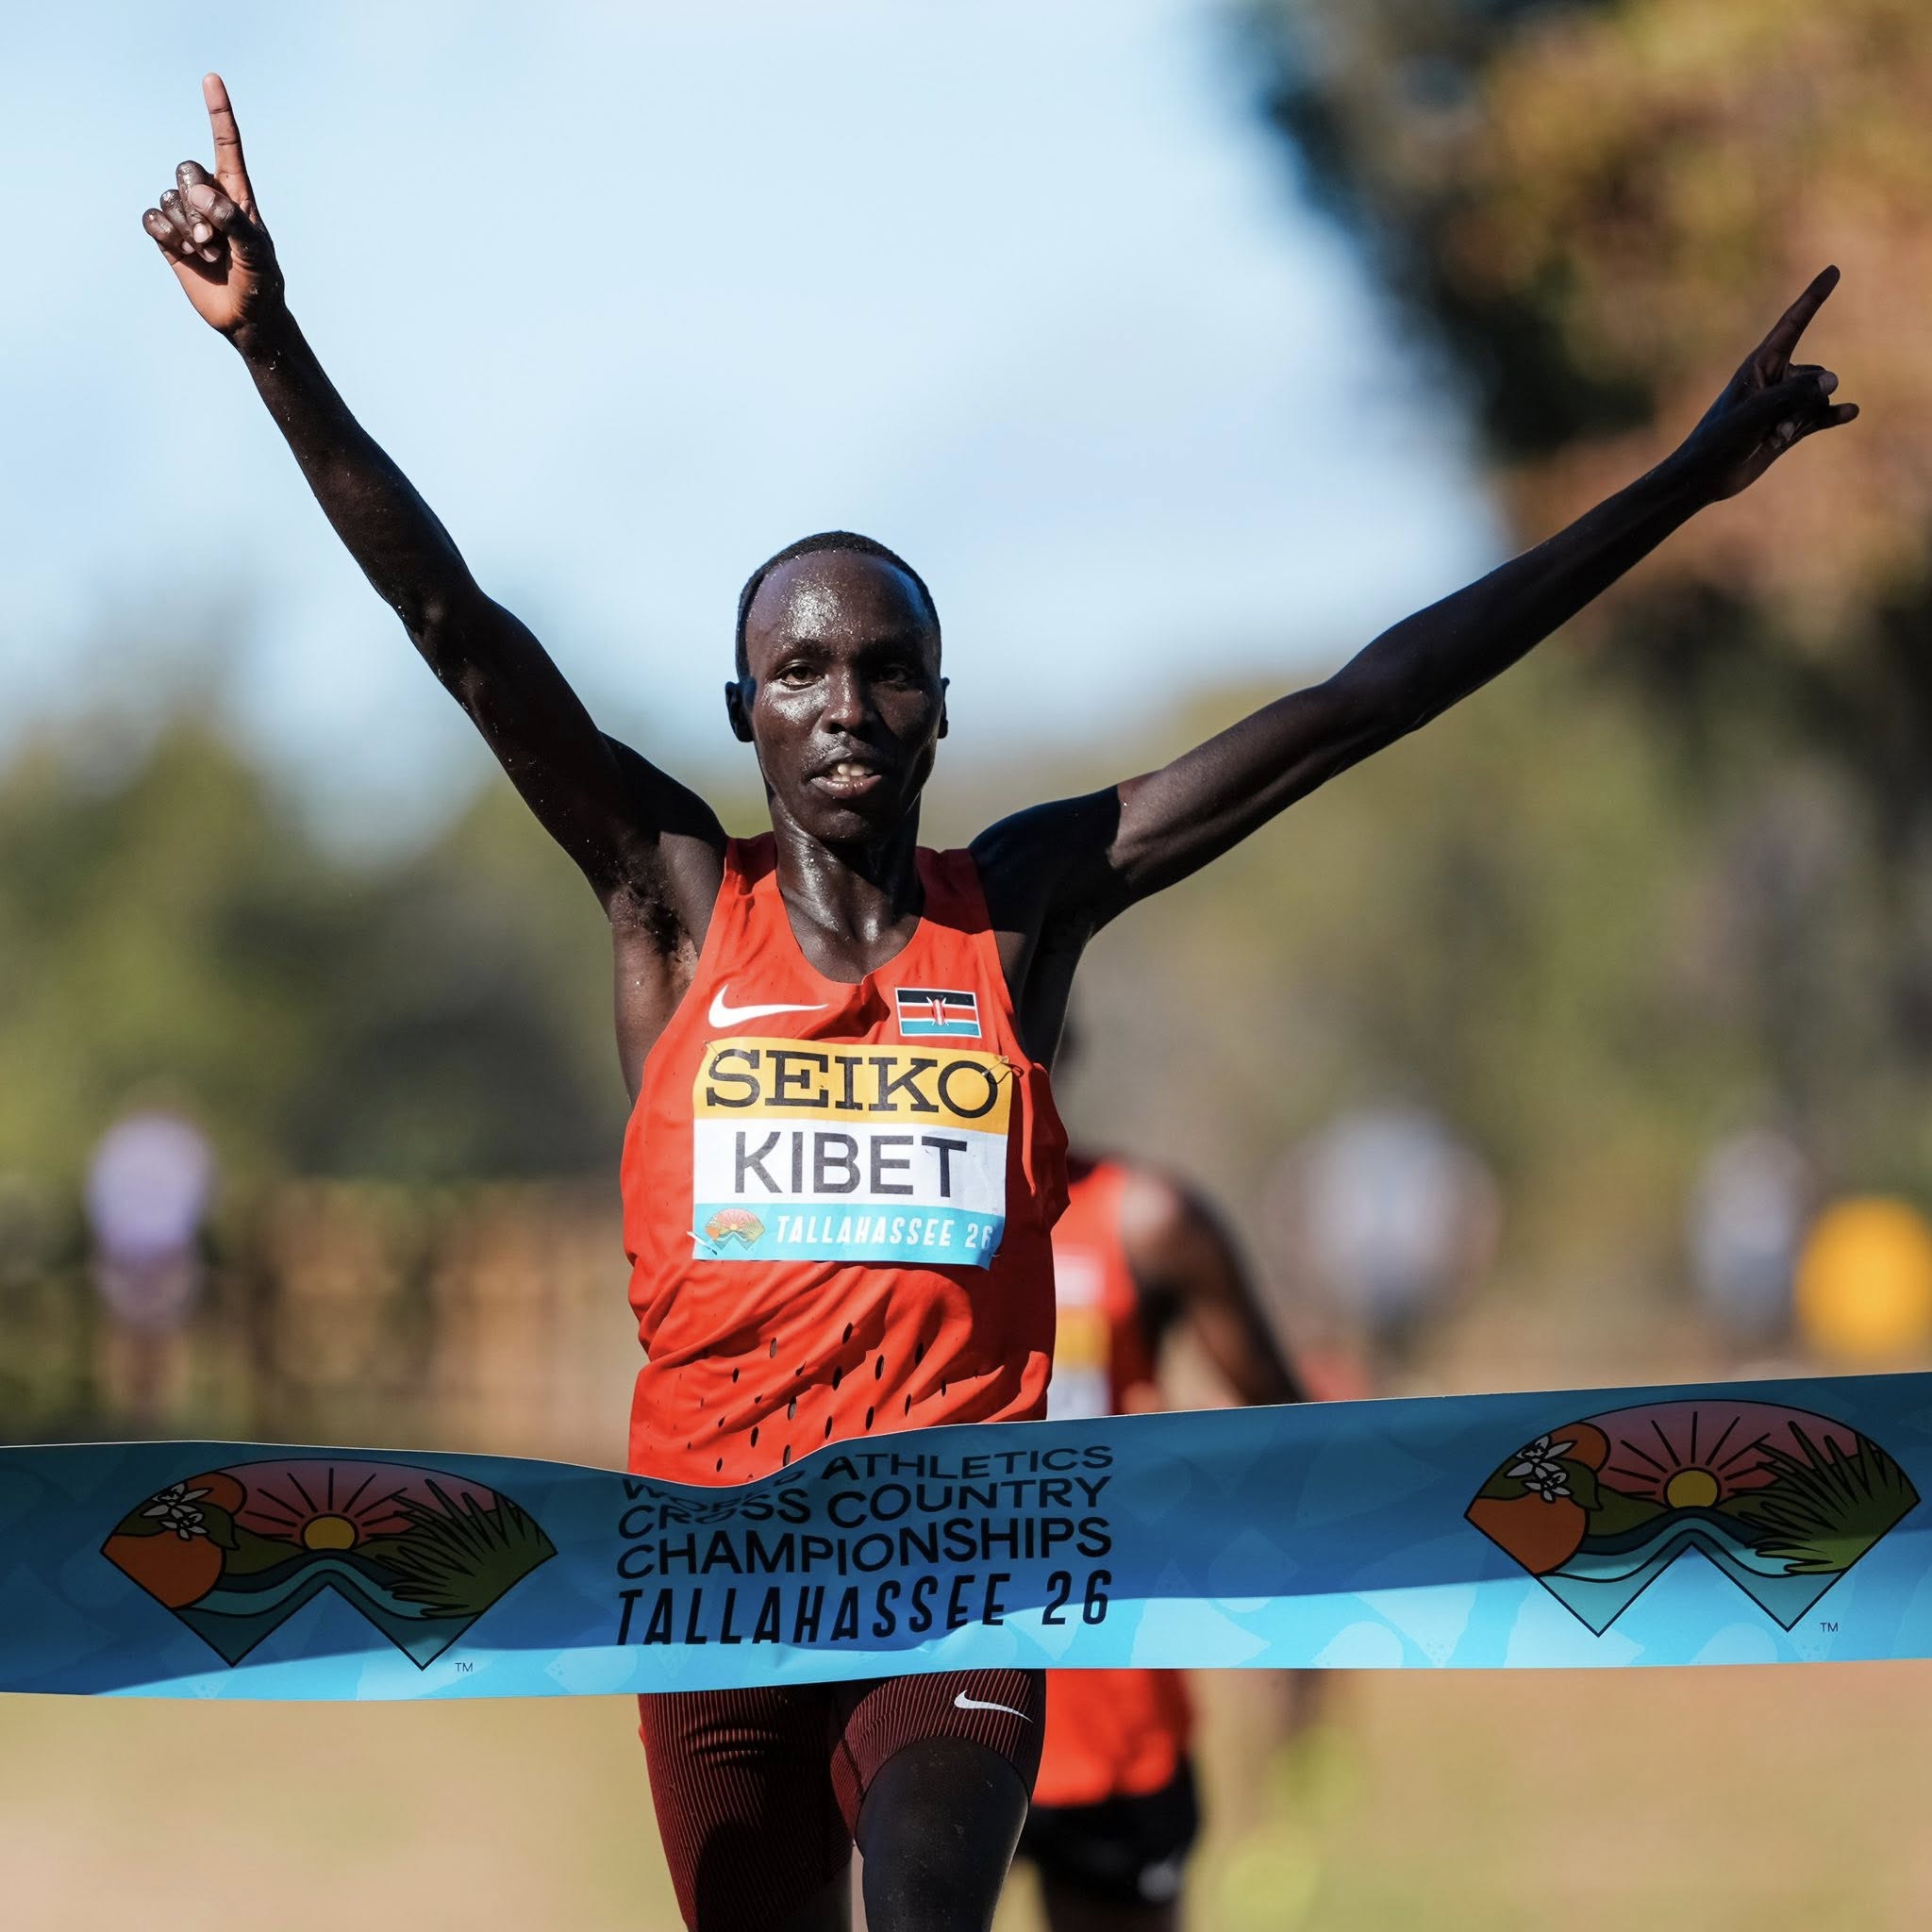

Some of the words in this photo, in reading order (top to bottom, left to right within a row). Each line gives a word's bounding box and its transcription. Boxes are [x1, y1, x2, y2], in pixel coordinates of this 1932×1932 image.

[706, 1048, 998, 1119] SEIKO
[734, 1131, 968, 1198] KIBET
[776, 1214, 955, 1247] TALLAHASSEE
[821, 1445, 1113, 1480] ATHLETICS
[618, 1488, 811, 1540] CROSS
[826, 1476, 1112, 1528] COUNTRY
[616, 1516, 1112, 1579] CHAMPIONSHIPS
[617, 1573, 1011, 1645] TALLAHASSEE
[1041, 1570, 1112, 1625] 26
[1819, 1622, 1839, 1633] TM
[455, 1662, 474, 1673] TM
